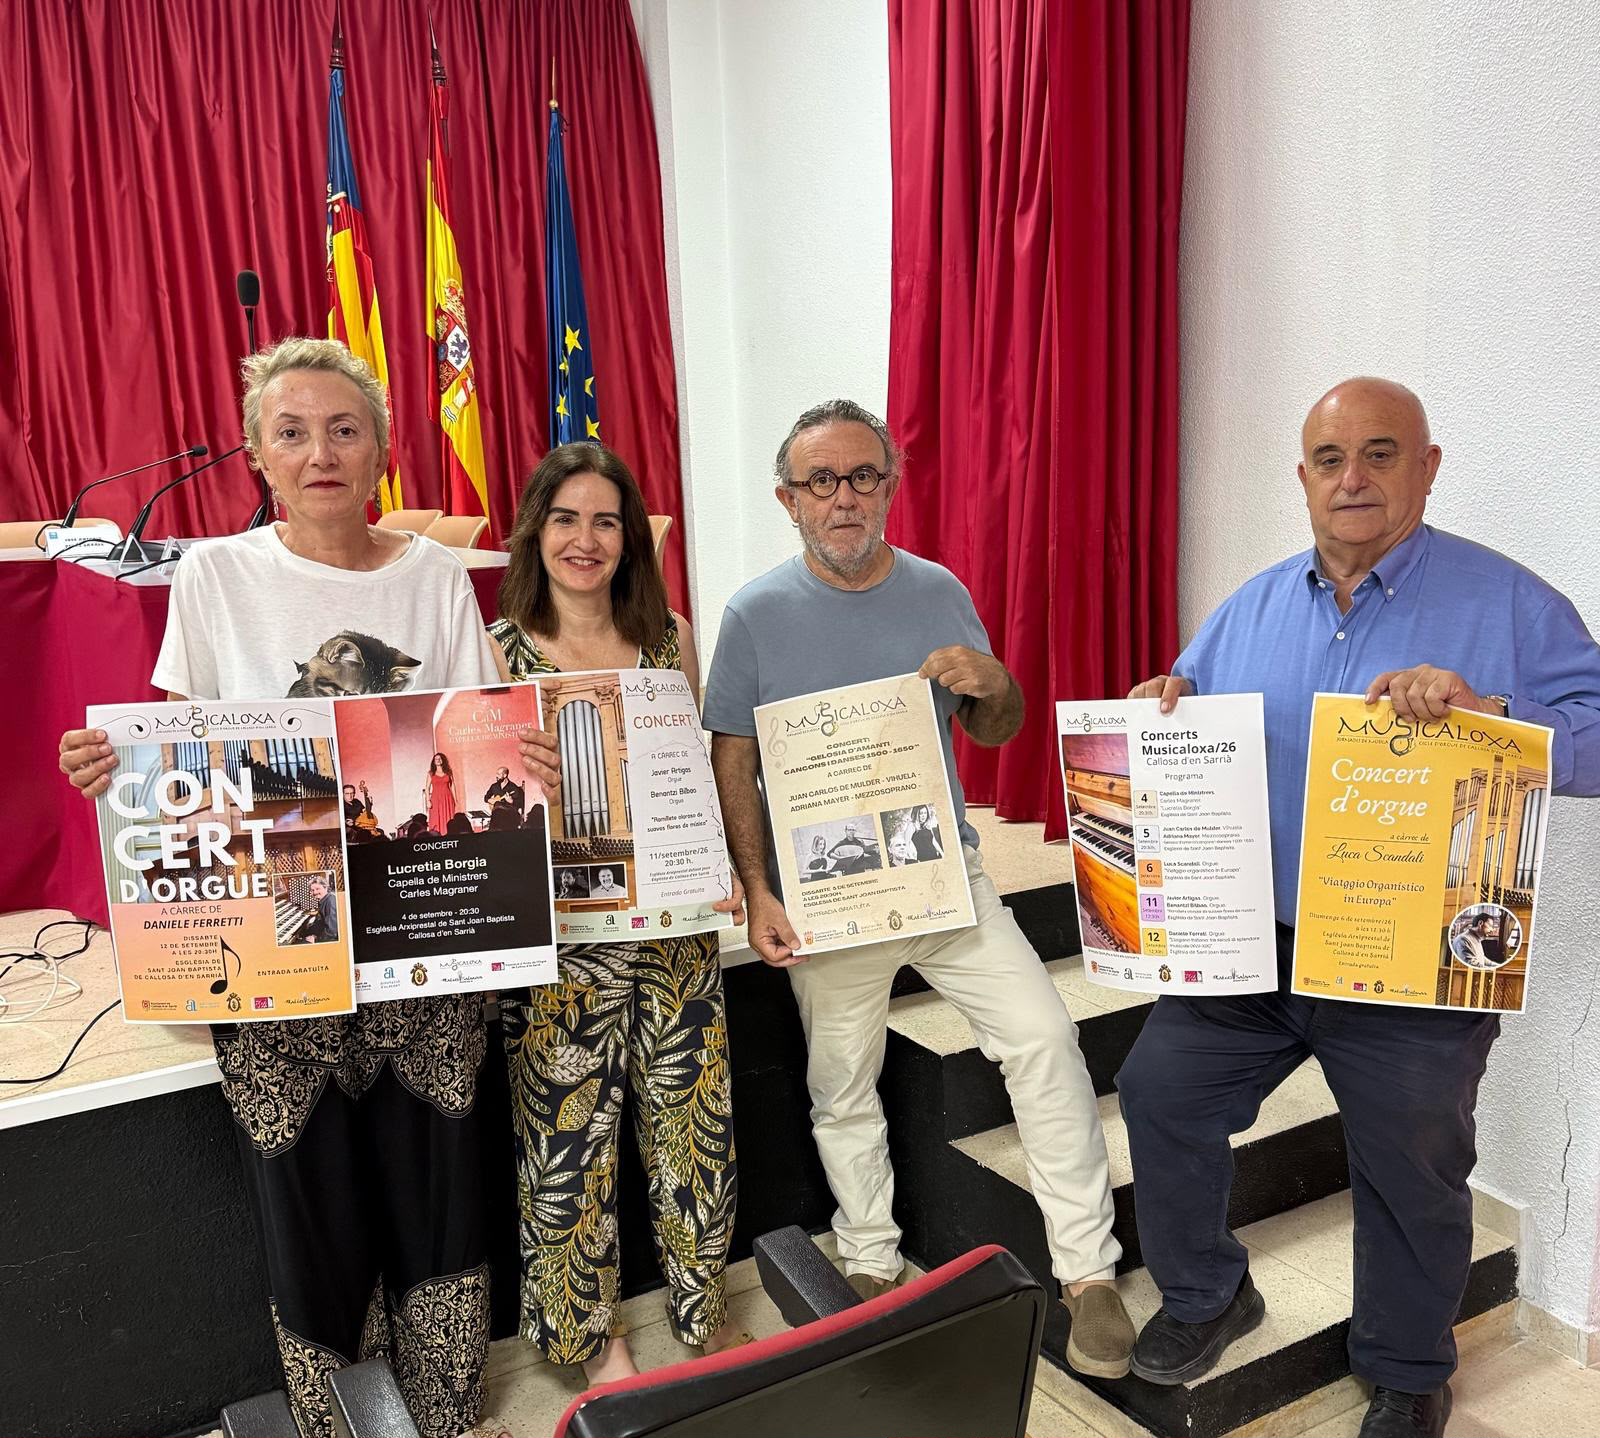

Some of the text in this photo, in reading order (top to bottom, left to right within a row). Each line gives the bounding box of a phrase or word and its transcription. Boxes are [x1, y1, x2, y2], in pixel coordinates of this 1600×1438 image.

[625, 676, 686, 702] MUSICALOXA
[155, 704, 276, 739] MUSICALOXA
[633, 714, 692, 729] CONCERT
[784, 696, 906, 737] MUSICALOXA
[1066, 712, 1127, 732] MUSICALOXA
[1140, 729, 1199, 742] Concerts
[1336, 711, 1523, 758] MUSICALOXA
[848, 741, 891, 754] D'AMANTI
[1142, 741, 1237, 756] Musicaloxa/26
[831, 753, 866, 766] DANSES
[866, 749, 888, 759] 1500
[1146, 754, 1232, 766] Callosa d'en Sarrià
[671, 767, 691, 775] Artigas
[827, 770, 833, 778] A
[1165, 773, 1204, 782] Programa
[1331, 758, 1432, 785] Concert
[107, 767, 255, 819] CON
[788, 771, 917, 802] JUAN CARLOS DE MULDER VIHUELA
[790, 783, 917, 813] ADRIANA MAYER MEZZOSOPRANO
[1141, 793, 1148, 802] 4
[1329, 784, 1428, 826] d'orgue
[647, 825, 666, 833] suaves
[666, 822, 682, 830] flores
[1143, 828, 1150, 838] 5
[1420, 832, 1429, 841] de
[113, 819, 274, 871] CERT
[413, 840, 459, 852] CONCERT
[649, 847, 709, 860] 11/setembre/26
[1326, 842, 1425, 864] Luca Scandali
[387, 857, 487, 876] Lucretia Borgia
[664, 858, 685, 867] 20:30
[1146, 863, 1153, 872] 6
[388, 872, 488, 889] Capella de Ministrers
[1366, 879, 1425, 892] Organistico
[119, 873, 269, 903] D'ORGUE
[400, 885, 479, 899] Carles Magraner
[1145, 897, 1157, 907] 11
[1344, 893, 1354, 903] in
[160, 904, 222, 916] A CÀRREC DE
[419, 910, 453, 919] setembre
[459, 907, 480, 915] 20:30
[143, 916, 243, 930] DANIELE FERRETTI
[1309, 912, 1339, 922] Diumenge
[366, 925, 397, 935] Església
[398, 921, 437, 931] Arxiprestal
[449, 918, 466, 926] Sant
[467, 917, 484, 925] Joan
[486, 914, 515, 924] Baptista
[408, 927, 476, 940] Callosa d'en Sarrià
[1147, 932, 1160, 942] 12
[1339, 940, 1354, 949] Joan
